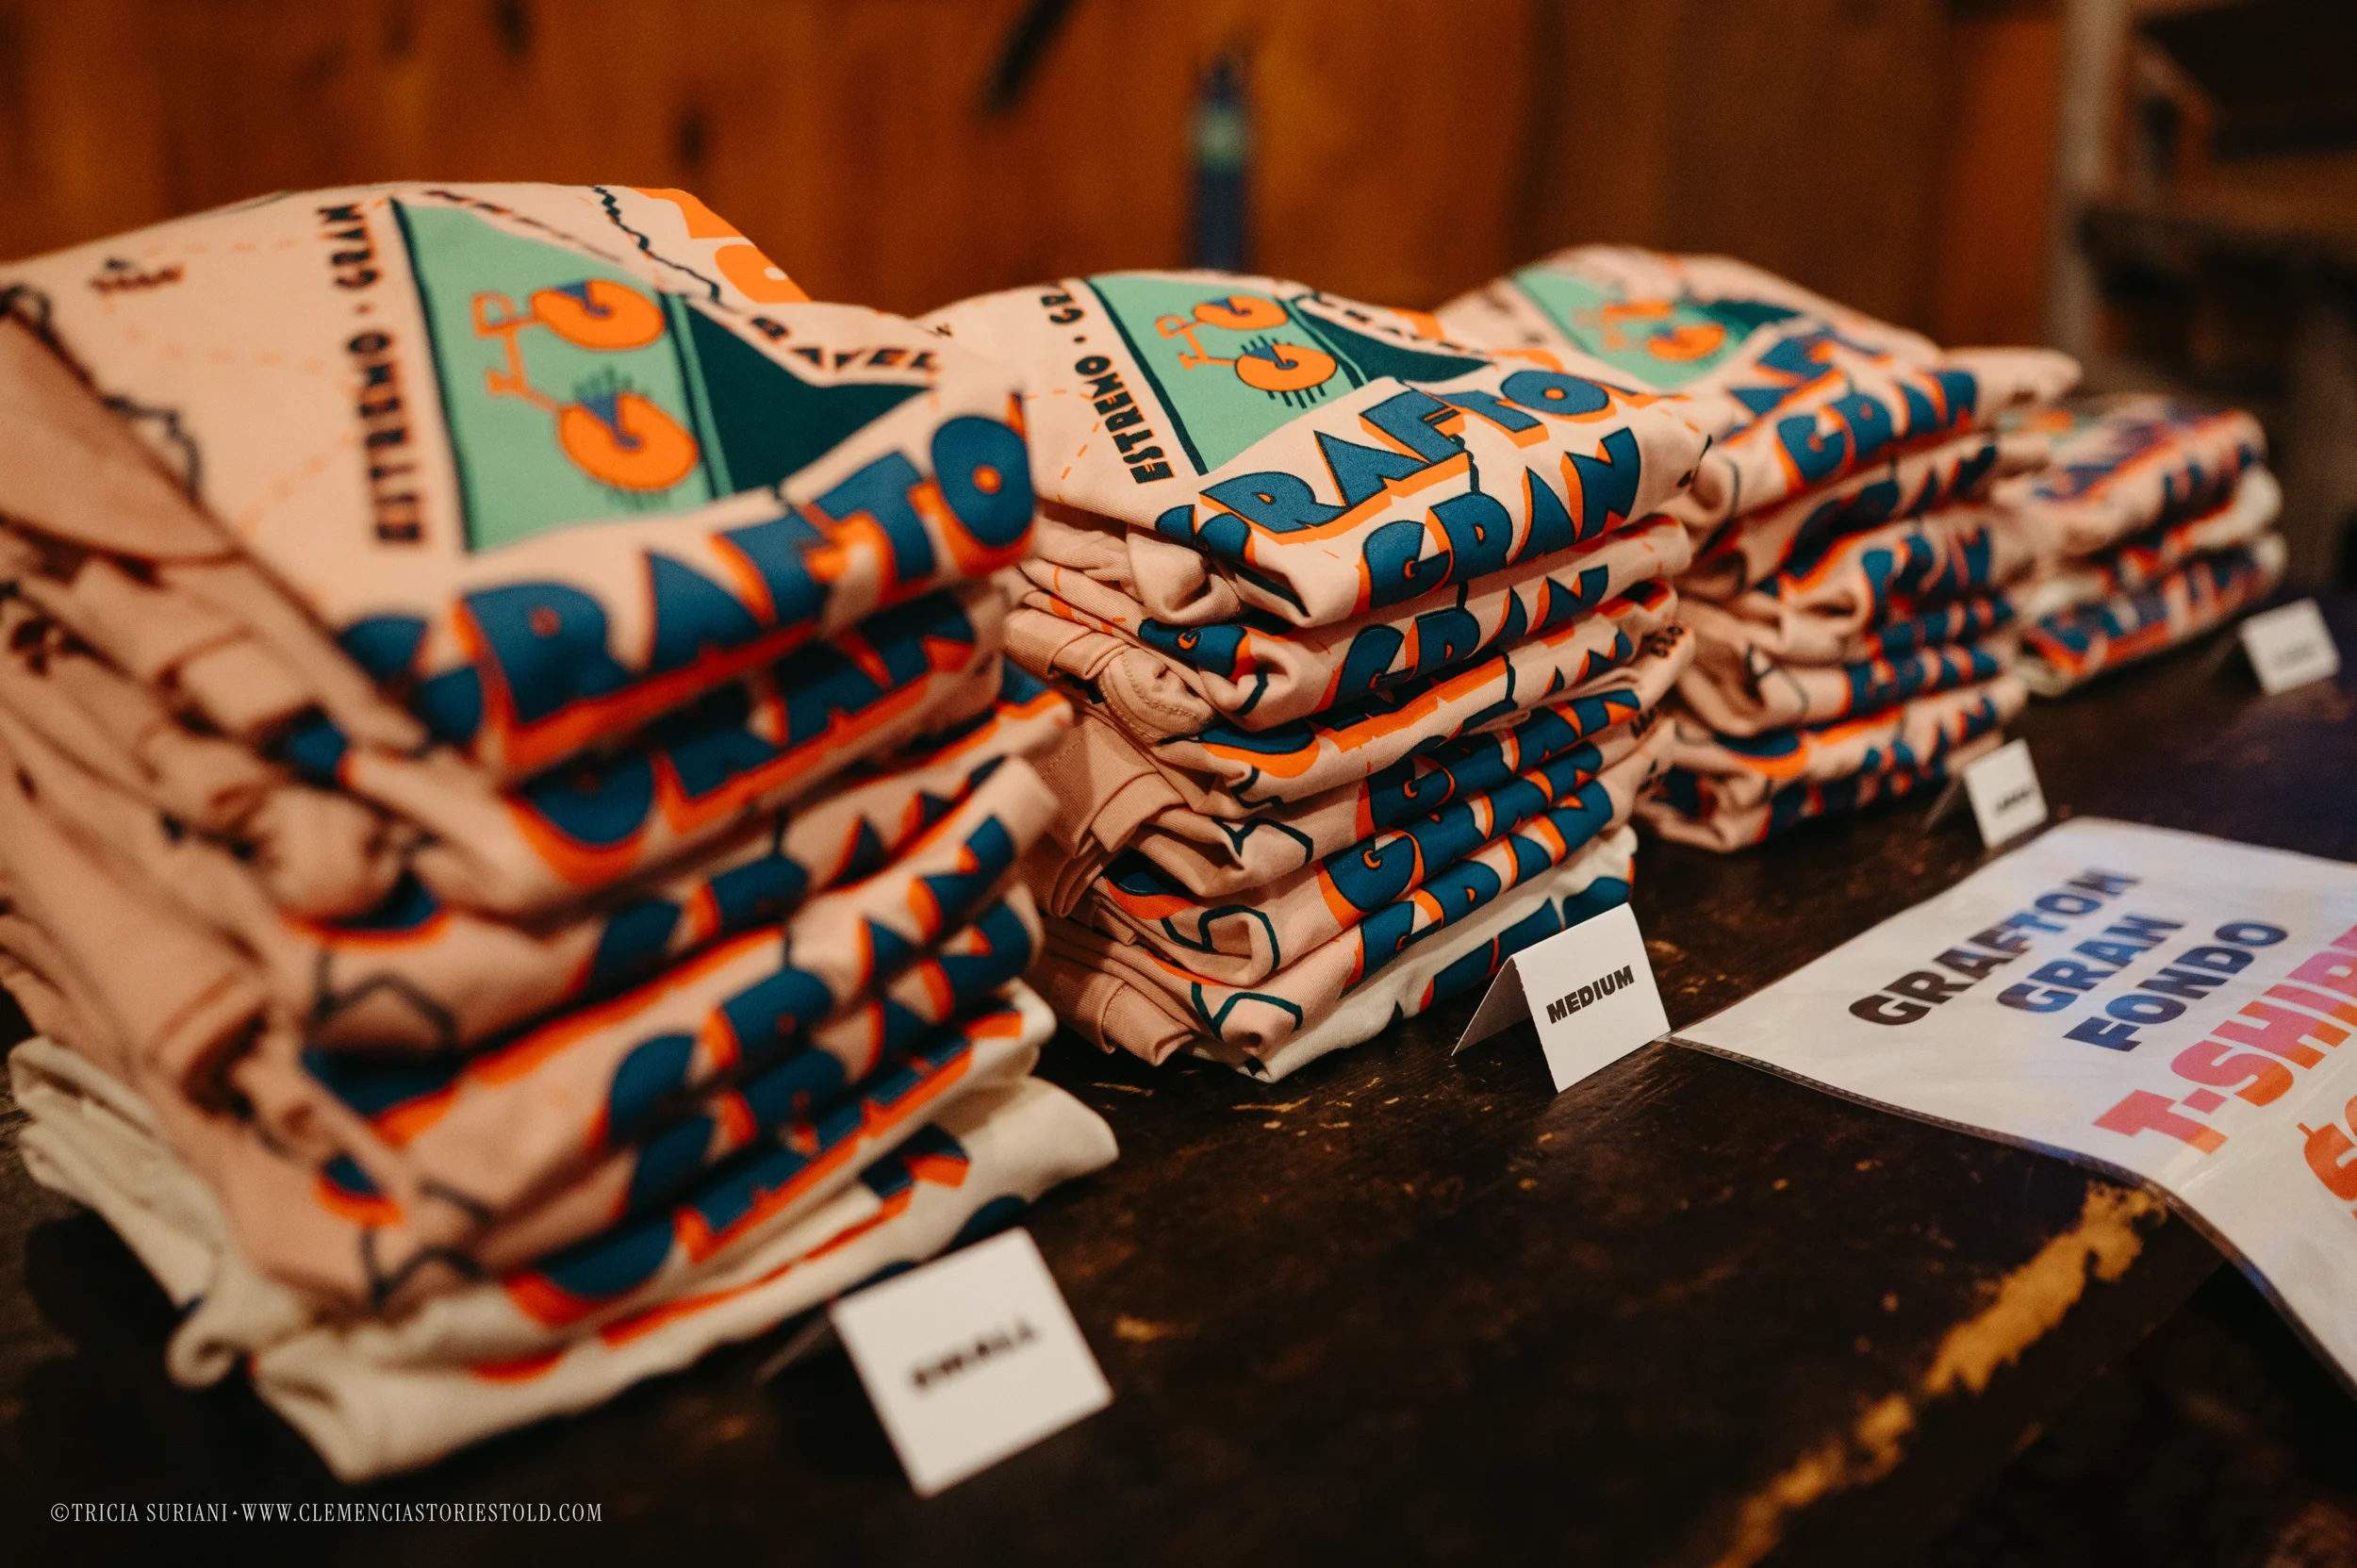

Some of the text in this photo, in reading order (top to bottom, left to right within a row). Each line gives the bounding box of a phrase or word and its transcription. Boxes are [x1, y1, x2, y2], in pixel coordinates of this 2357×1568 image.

[1075, 355, 1176, 485] ESTREMO
[1359, 427, 1642, 611] GRAN
[1545, 965, 1635, 1025] MEDIUM
[1848, 866, 2144, 1027] GRAFTON
[1996, 913, 2185, 1014] GRAN
[2062, 919, 2288, 1053] FONDO
[2091, 922, 2357, 1156] T-SHIR
